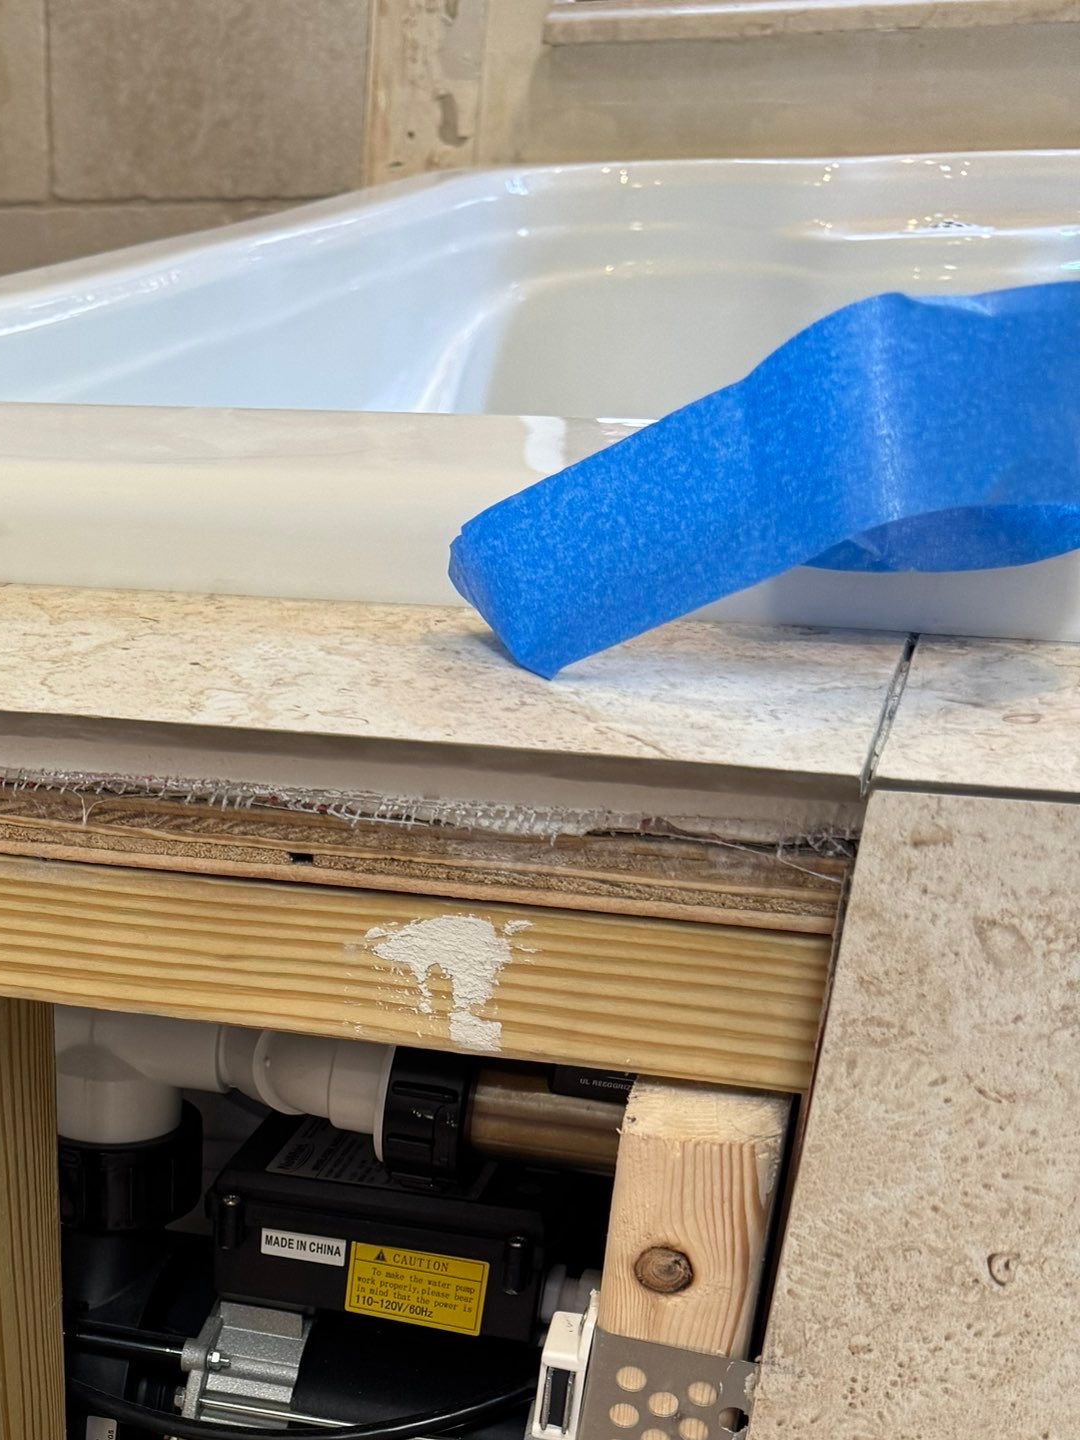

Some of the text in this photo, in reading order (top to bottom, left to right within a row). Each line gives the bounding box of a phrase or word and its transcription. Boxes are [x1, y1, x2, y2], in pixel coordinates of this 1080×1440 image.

[265, 1234, 341, 1257] MADE IN CHINA
[392, 1253, 449, 1272] CAUTION
[357, 1274, 376, 1285] work
[454, 1292, 474, 1303] bear
[371, 1267, 476, 1295] To make the water pump
[369, 1287, 389, 1297] mind
[393, 1290, 411, 1301] that
[416, 1293, 430, 1305] the
[434, 1300, 458, 1312] power
[463, 1303, 473, 1313] is
